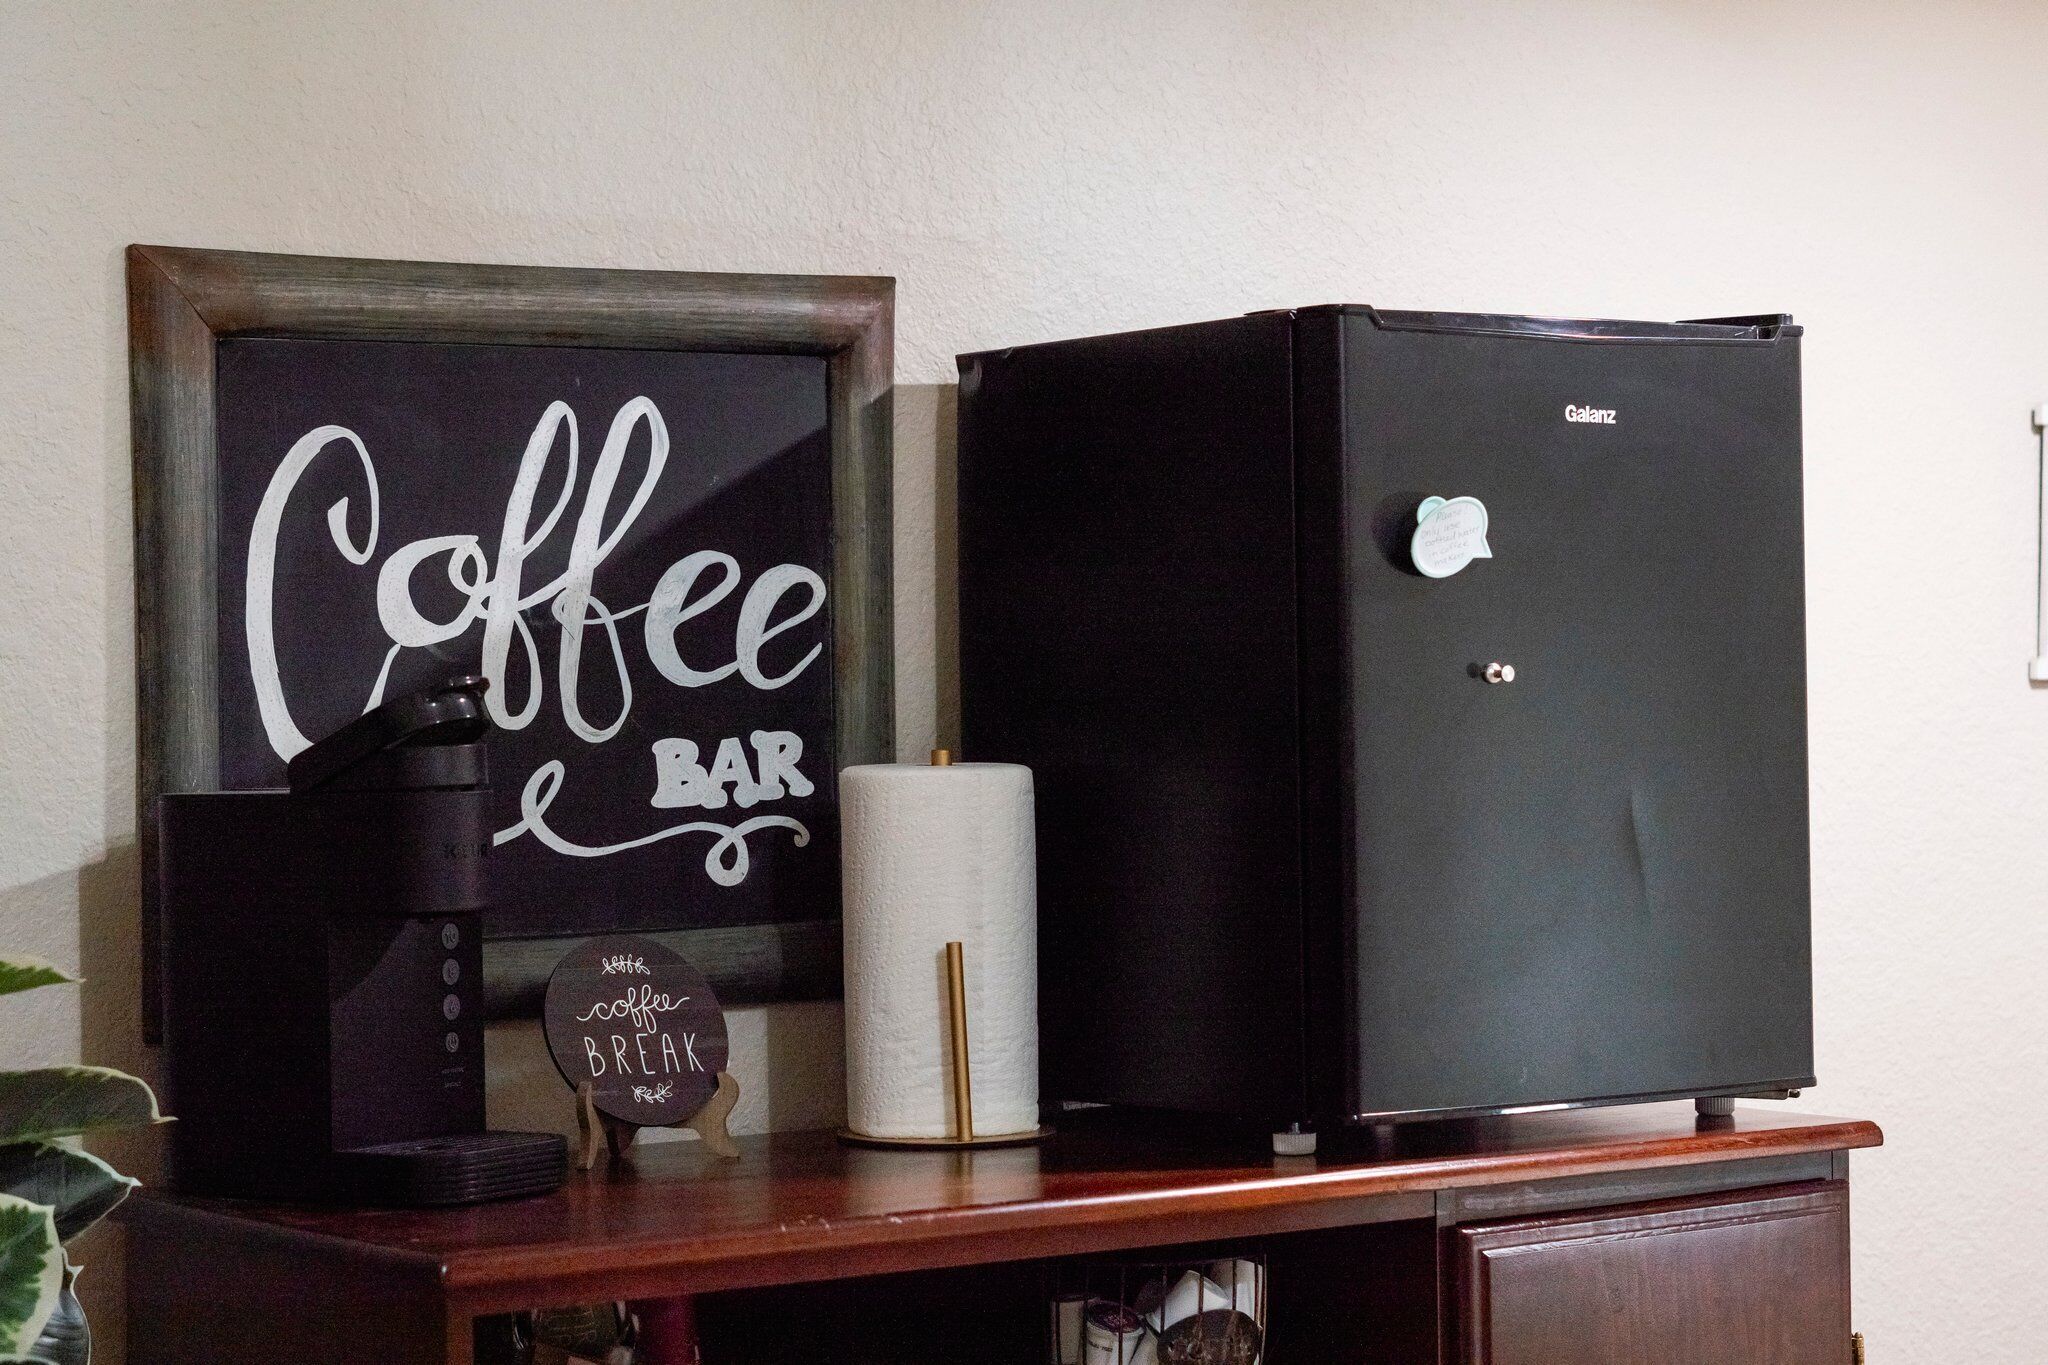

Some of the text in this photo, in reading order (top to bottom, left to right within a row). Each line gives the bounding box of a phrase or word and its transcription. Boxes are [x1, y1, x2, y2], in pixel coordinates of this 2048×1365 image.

[1565, 404, 1616, 424] Galanz
[246, 396, 826, 763] Coffee
[651, 730, 814, 808] BAR
[576, 984, 690, 1034] coffee
[584, 1032, 704, 1076] BREAK
